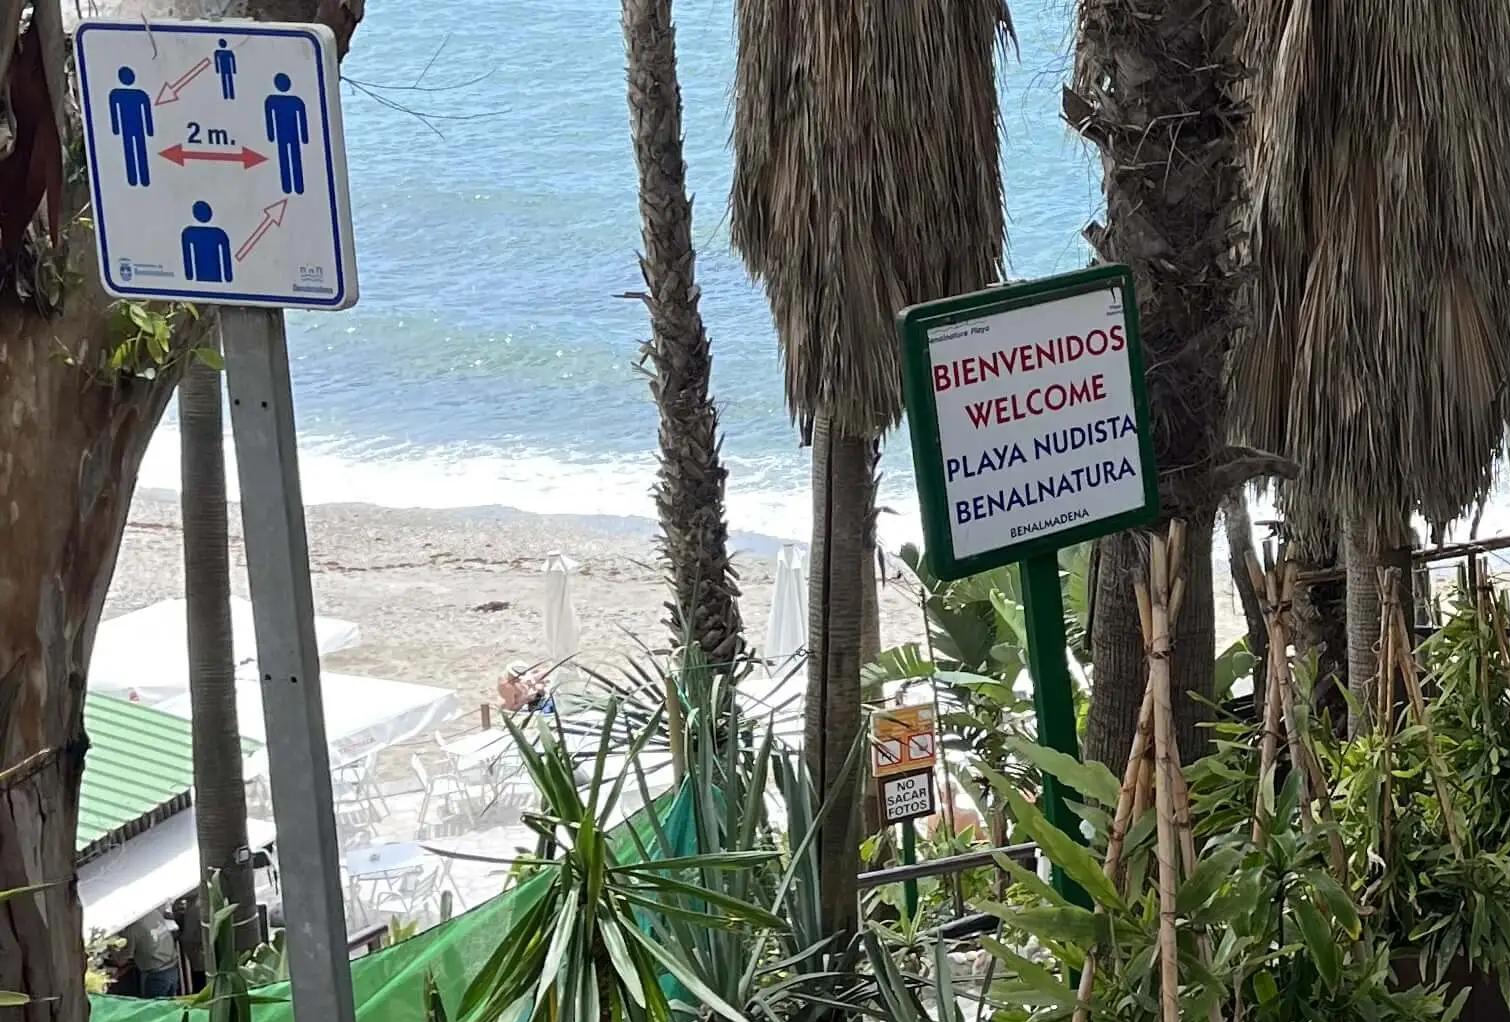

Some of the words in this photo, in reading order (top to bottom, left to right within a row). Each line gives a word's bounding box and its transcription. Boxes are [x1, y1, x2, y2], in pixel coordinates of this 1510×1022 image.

[187, 122, 202, 144] 2
[208, 130, 236, 146] m.
[933, 325, 1125, 392] BIENVENIDOS
[965, 374, 1107, 429] WELCOME
[946, 444, 1027, 483] PLAYA
[1034, 414, 1138, 460] NUDISTA
[956, 457, 1136, 524] BENALNATURA
[1010, 508, 1090, 539] BENALMADENA
[887, 787, 927, 807] SACAR
[896, 779, 915, 792] NO
[888, 800, 928, 817] FOTOS
